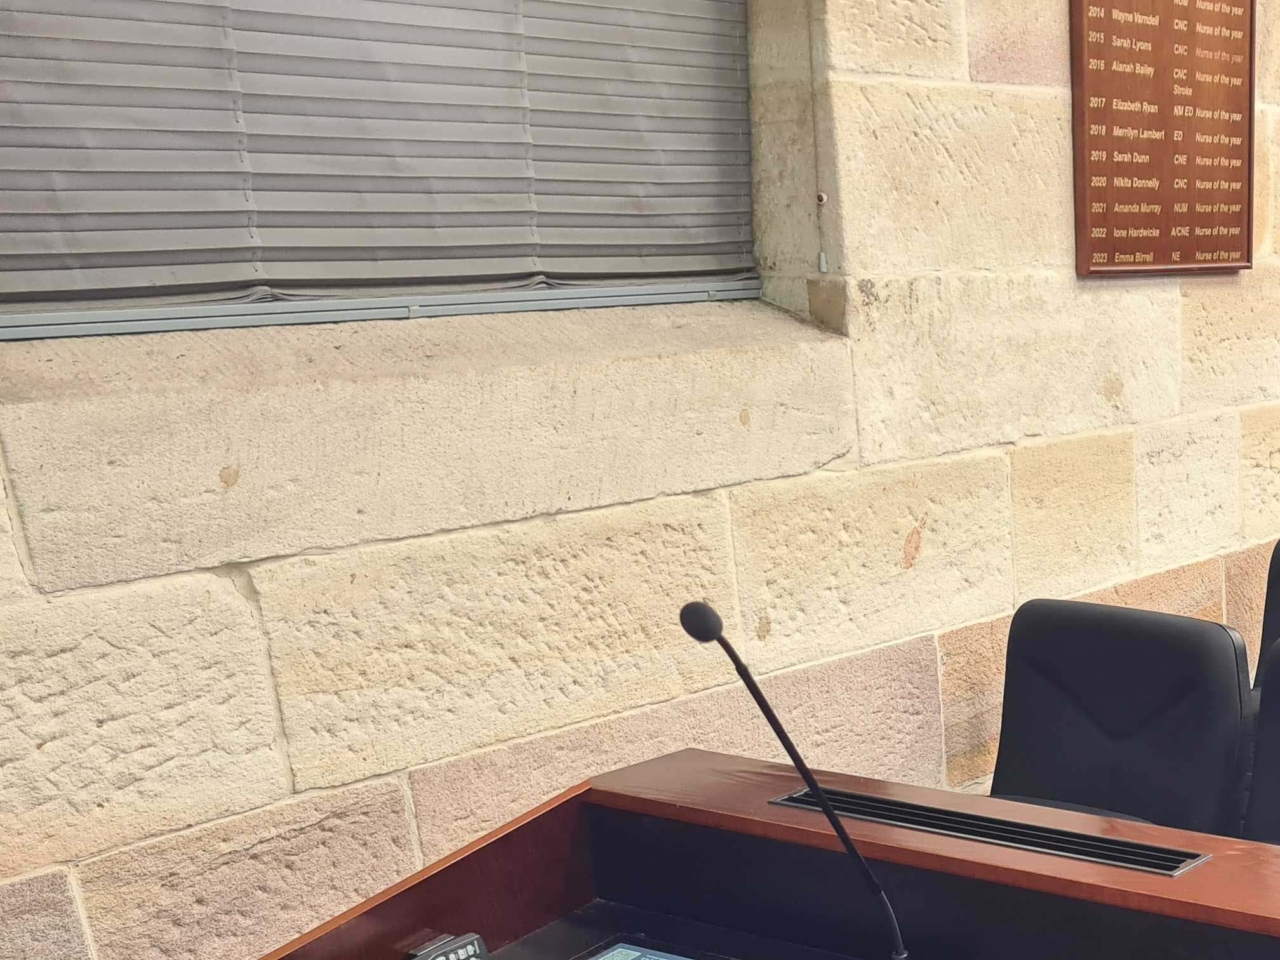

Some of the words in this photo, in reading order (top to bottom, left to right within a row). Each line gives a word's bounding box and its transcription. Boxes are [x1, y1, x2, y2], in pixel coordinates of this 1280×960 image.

[1089, 6, 1104, 18] 2014
[1112, 9, 1132, 23] Wayne
[1134, 12, 1159, 25] Varndell
[1174, 19, 1188, 31] CNC
[1196, 22, 1213, 35] Nurse
[1214, 26, 1220, 36] of
[1221, 27, 1230, 36] the
[1231, 30, 1243, 39] year
[1089, 31, 1104, 43] 2015
[1112, 36, 1131, 48] Sarah
[1132, 39, 1151, 51] Lyons
[1174, 44, 1188, 55] CNC
[1089, 59, 1104, 70] 2016
[1112, 61, 1134, 72] Alanah
[1135, 63, 1155, 77] Bailey
[1174, 69, 1187, 79] CNC
[1173, 84, 1192, 95] Stroke
[1090, 97, 1105, 107] 2017
[1113, 99, 1140, 111] Elizabeth
[1143, 102, 1158, 113] Ryan
[1174, 105, 1183, 116] NM
[1185, 106, 1193, 116] ED
[1090, 125, 1106, 135] 2018
[1113, 126, 1138, 139] Merrilyn
[1140, 128, 1164, 139] Lambert
[1174, 131, 1183, 140] ED
[1091, 151, 1106, 161] 2019
[1113, 151, 1131, 162] Sarah
[1133, 152, 1149, 162] Dunn
[1174, 155, 1187, 165] CNE
[1091, 177, 1106, 187] 2020
[1114, 177, 1131, 187] Nikita
[1133, 177, 1159, 190] Donnelly
[1174, 179, 1187, 188] CNC
[1092, 203, 1106, 212] 2021
[1114, 203, 1139, 212] Amanda
[1141, 203, 1161, 214] Murray
[1174, 203, 1188, 212] NUM
[1091, 228, 1106, 237] 2022
[1114, 228, 1127, 237] Ione
[1128, 228, 1159, 237] Hardwicke
[1171, 227, 1190, 236] A/CNE
[1195, 227, 1211, 236] Nurse
[1213, 226, 1219, 235] of
[1220, 226, 1228, 235] the
[1229, 227, 1240, 236] year
[1093, 253, 1107, 262] 2023
[1115, 253, 1134, 262] Emma
[1135, 252, 1153, 262] Birrell
[1172, 252, 1180, 261] NE
